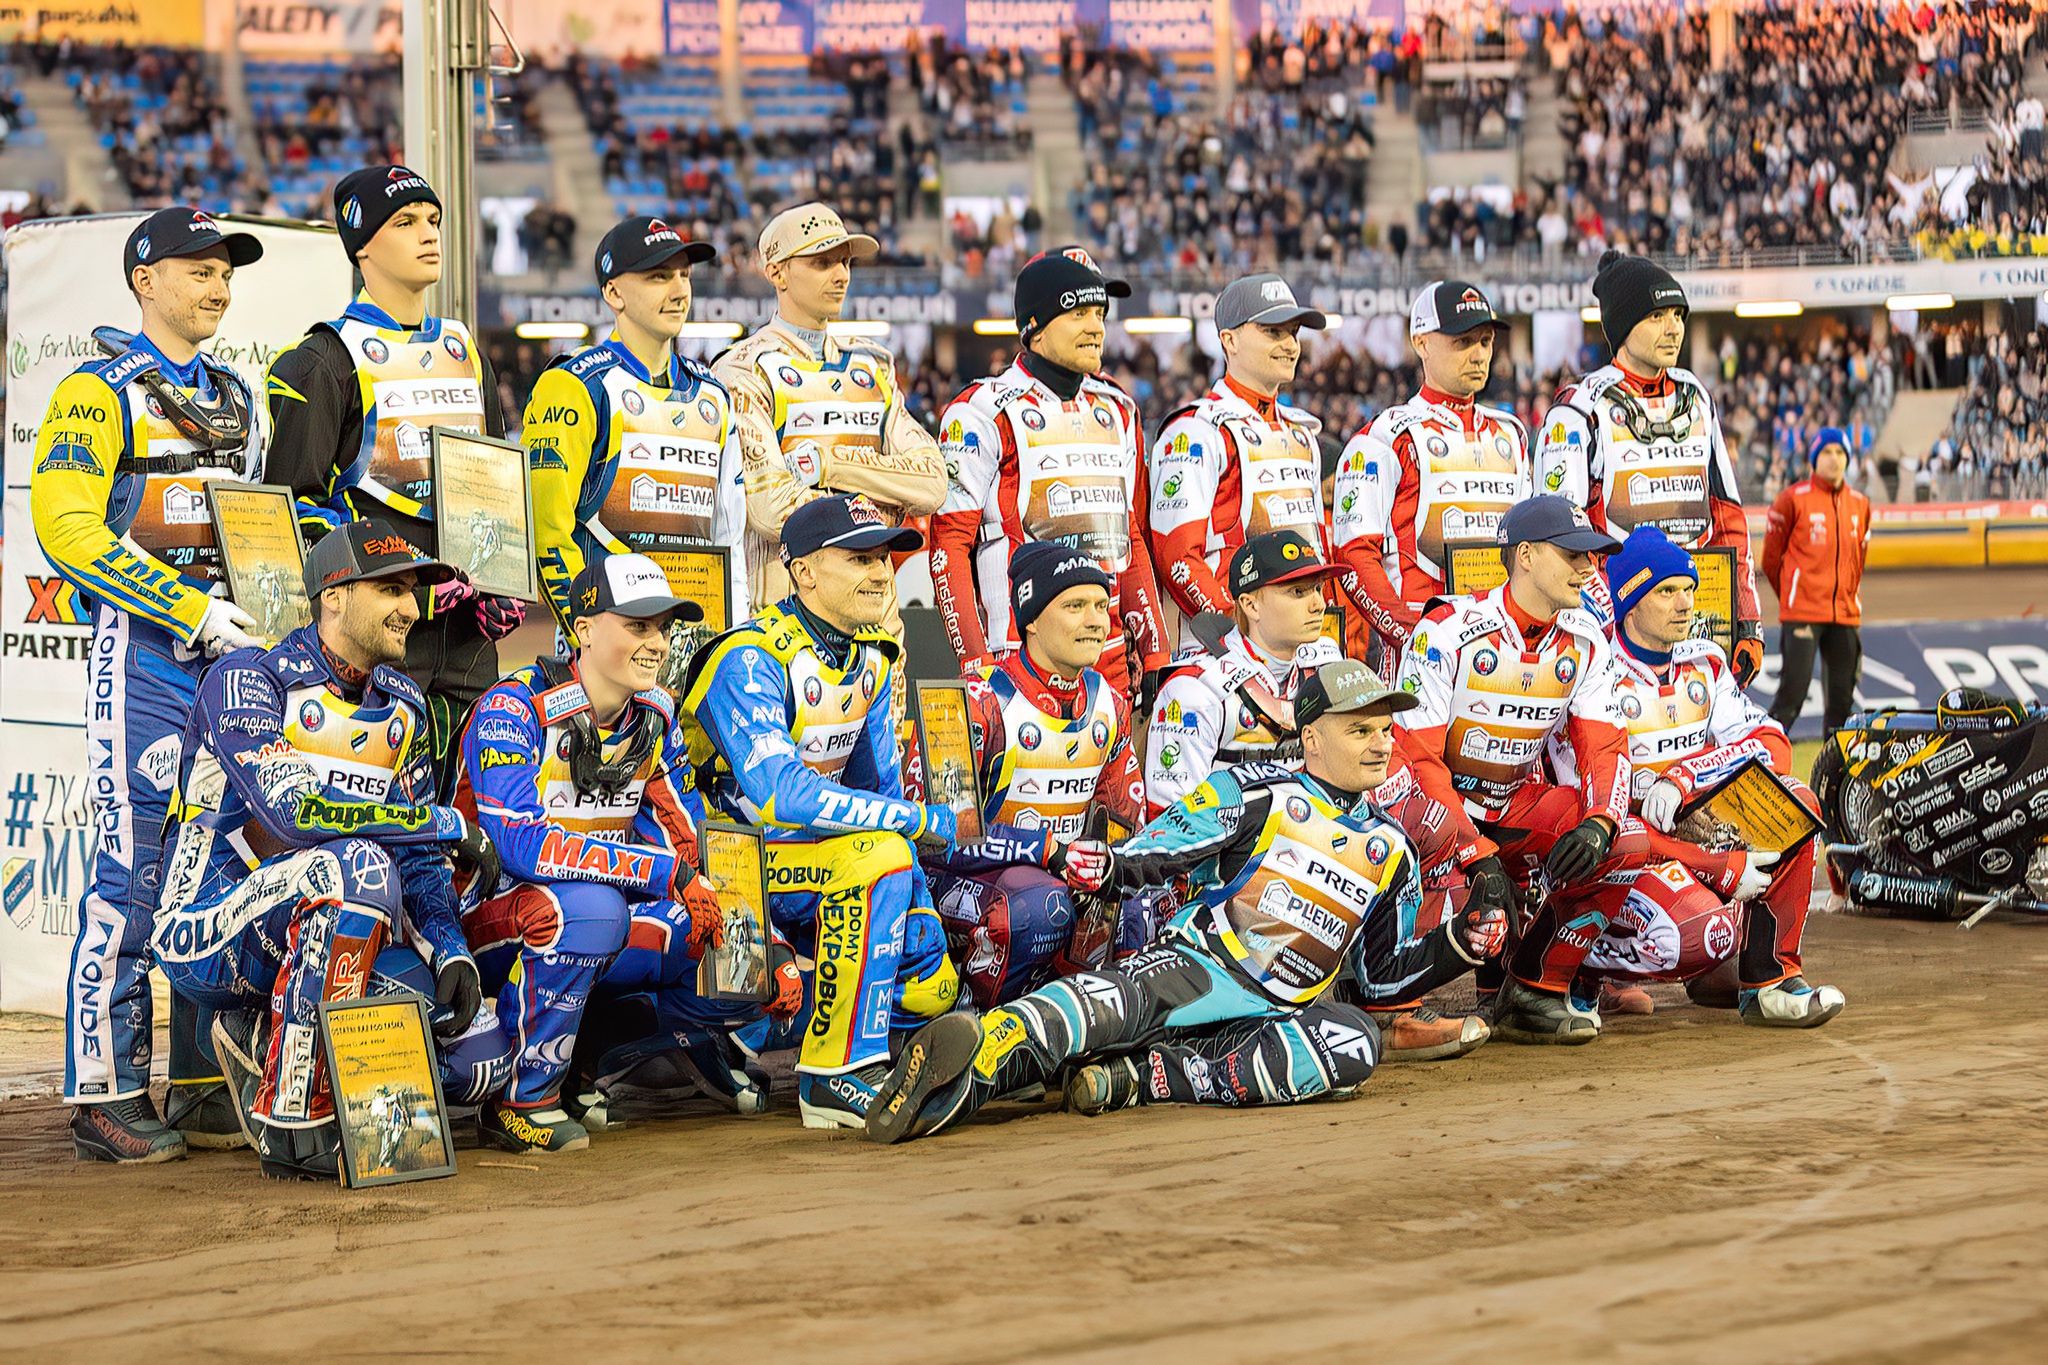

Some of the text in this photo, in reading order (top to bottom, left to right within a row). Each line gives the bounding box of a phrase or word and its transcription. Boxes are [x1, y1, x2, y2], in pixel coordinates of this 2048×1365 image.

[411, 387, 477, 405] PRES
[67, 404, 107, 423] AVO
[542, 405, 579, 426] AVO
[822, 411, 880, 426] PRES
[660, 445, 718, 468] PRES
[1065, 452, 1123, 468] PRES
[1647, 445, 1704, 460] PRES
[655, 484, 714, 507] PLEWA
[1070, 489, 1124, 504] PLEWA
[1463, 480, 1515, 496] PRES
[1650, 477, 1703, 494] PLEWA
[102, 541, 185, 601] TMC
[936, 571, 967, 657] instaforex
[1355, 584, 1411, 644] instaforex
[1459, 619, 1498, 642] PRES
[95, 635, 118, 722] ONDE
[1497, 703, 1561, 721] PRES
[1657, 729, 1706, 754] PRES
[328, 769, 388, 797] PRES
[2001, 778, 2028, 801] DUAL
[574, 791, 640, 809] PRES
[816, 789, 912, 831] TMC
[539, 830, 654, 882] MAXI
[1306, 859, 1370, 907] PRES
[1286, 896, 1347, 942] PLEWA
[845, 905, 863, 964] DOMY
[811, 904, 845, 1037] EXPOBUD
[79, 958, 104, 1058] ONDE
